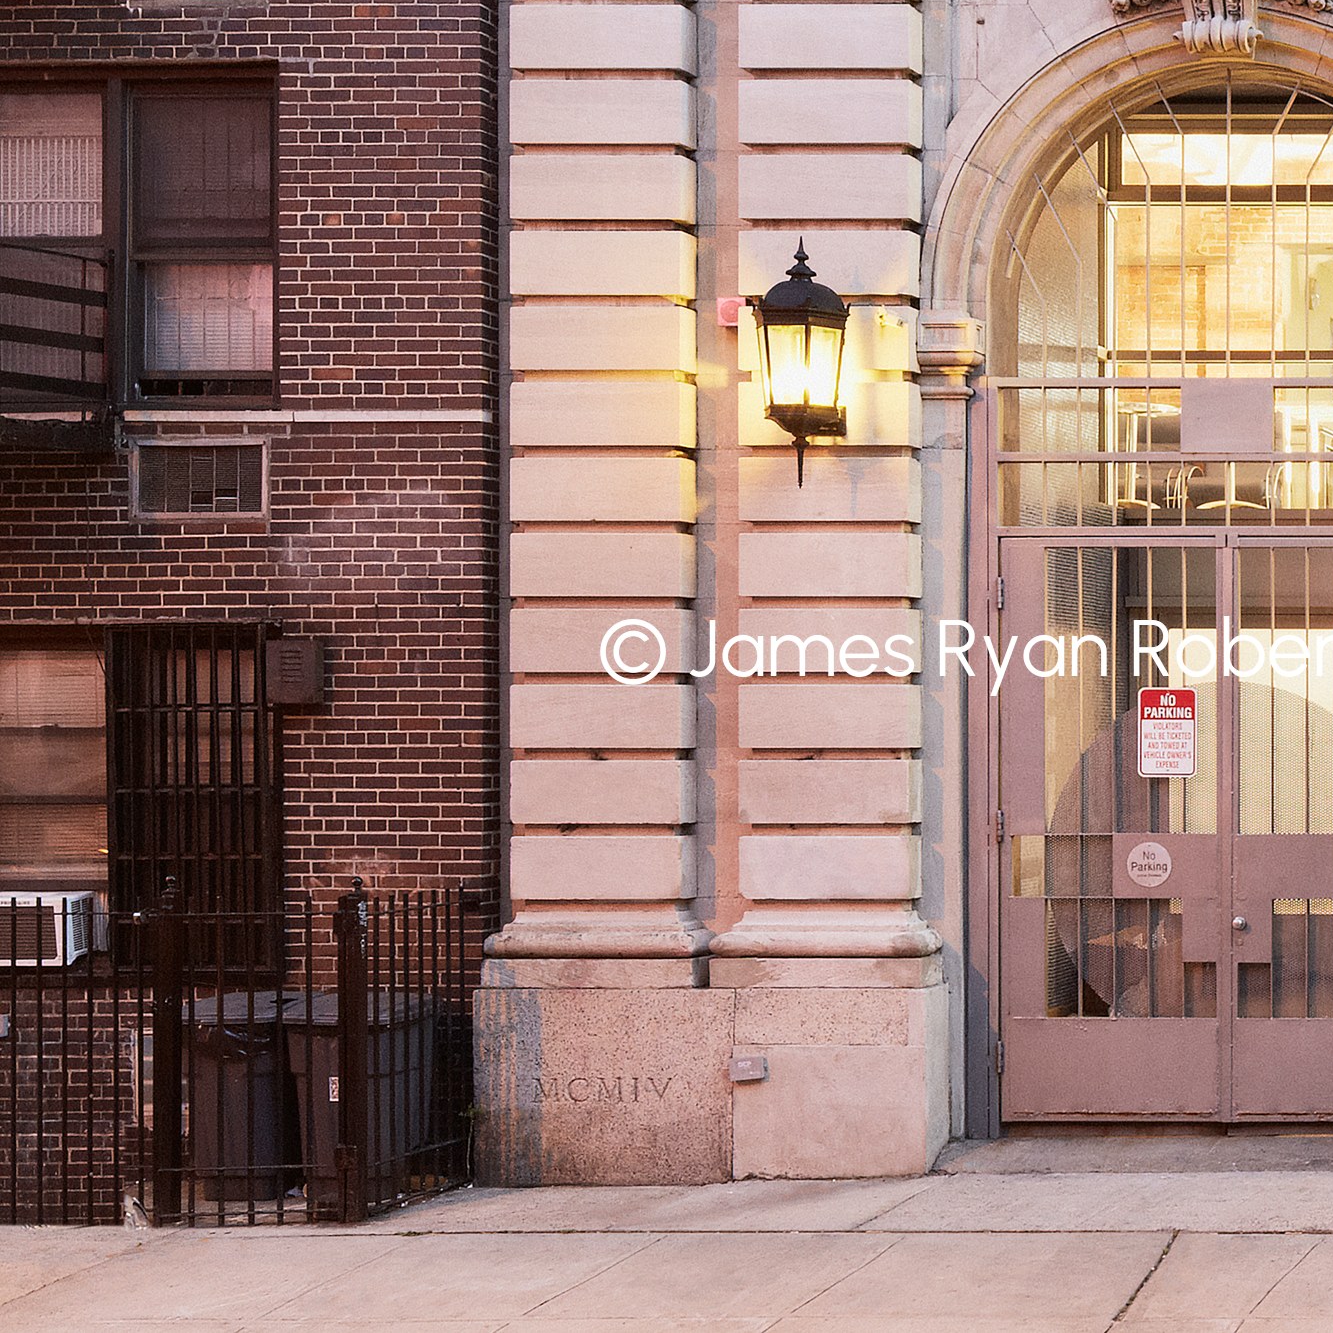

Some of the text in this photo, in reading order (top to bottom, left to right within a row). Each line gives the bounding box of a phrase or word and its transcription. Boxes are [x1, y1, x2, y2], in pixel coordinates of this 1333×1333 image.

[1160, 694, 1176, 706] NO
[1143, 707, 1193, 719] PARKING
[1142, 851, 1156, 861] No
[1131, 861, 1168, 874] Parking
[532, 1076, 674, 1103] MCMIV
